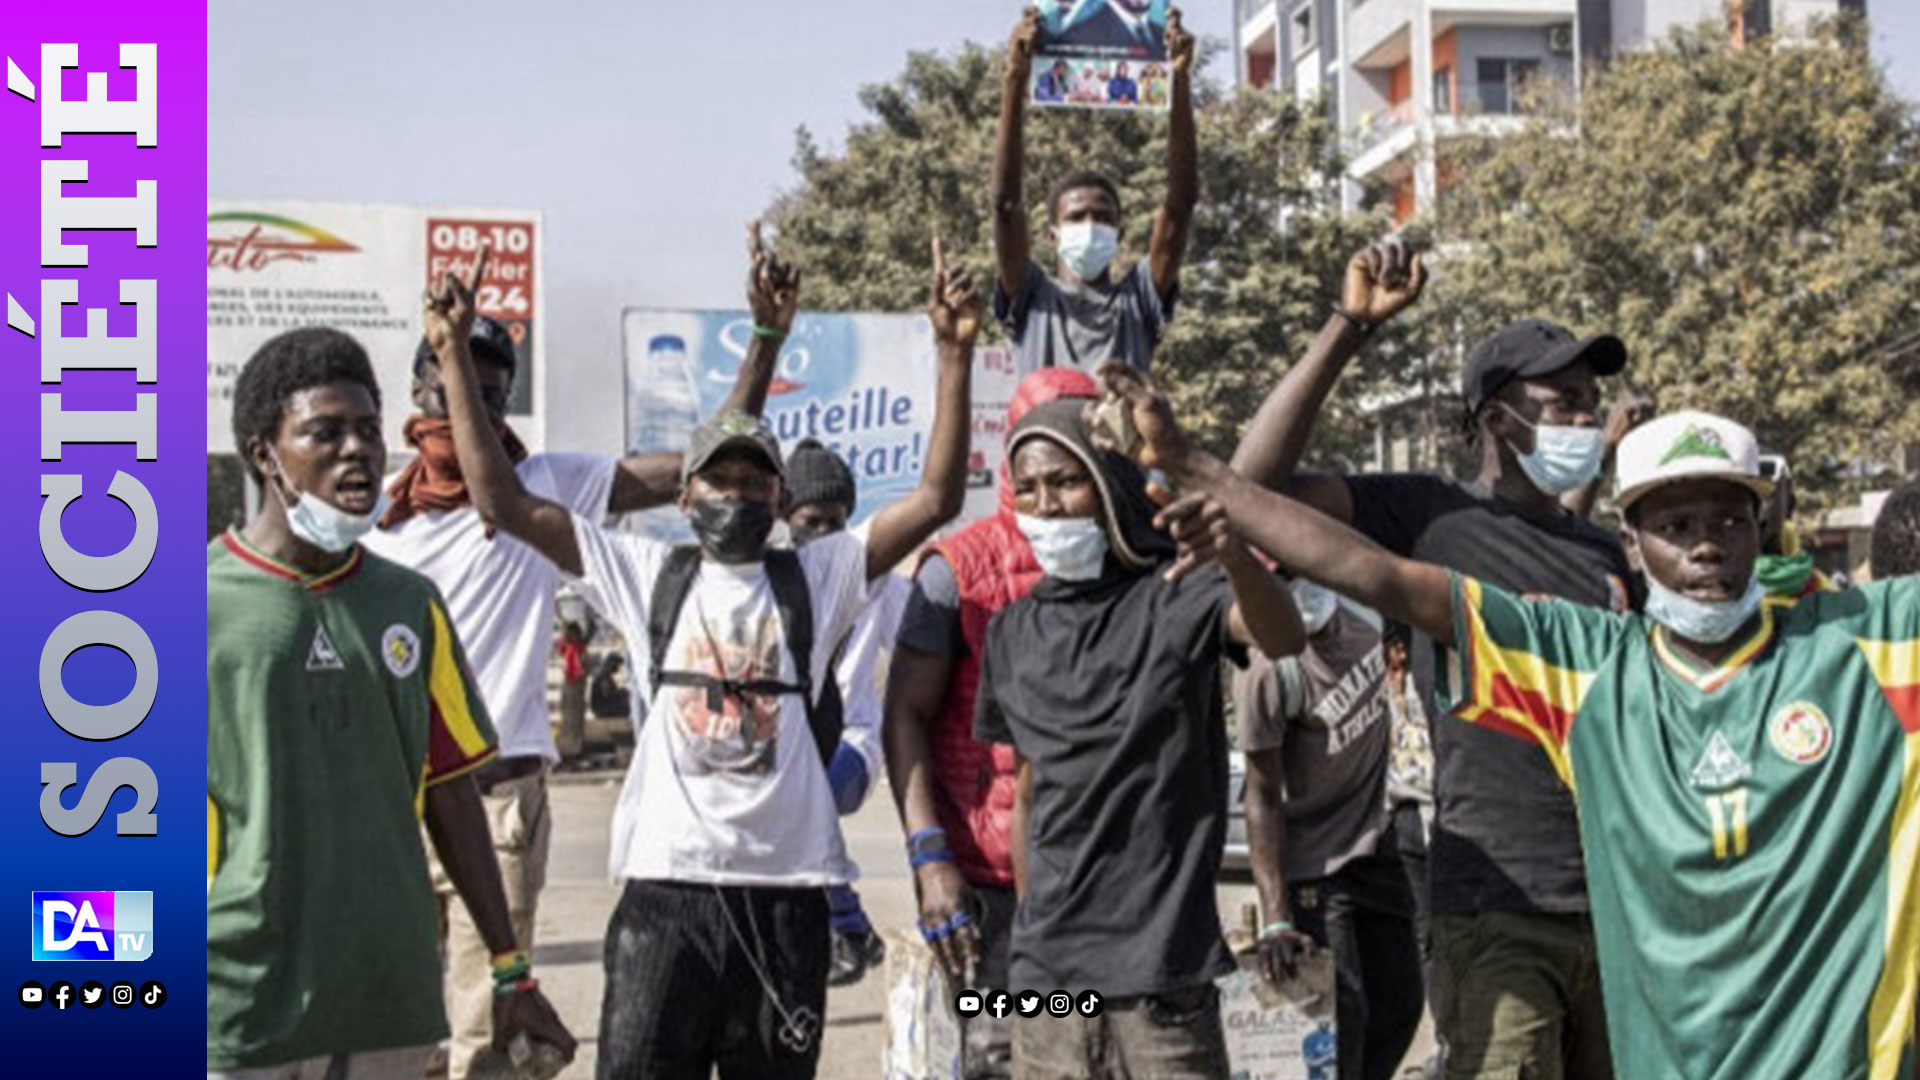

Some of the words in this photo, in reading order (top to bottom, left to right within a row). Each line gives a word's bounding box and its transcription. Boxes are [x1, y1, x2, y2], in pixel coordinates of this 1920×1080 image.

[432, 225, 529, 253] 08-10
[250, 287, 270, 300] DE
[259, 317, 279, 329] DE
[1705, 787, 1748, 860] 17
